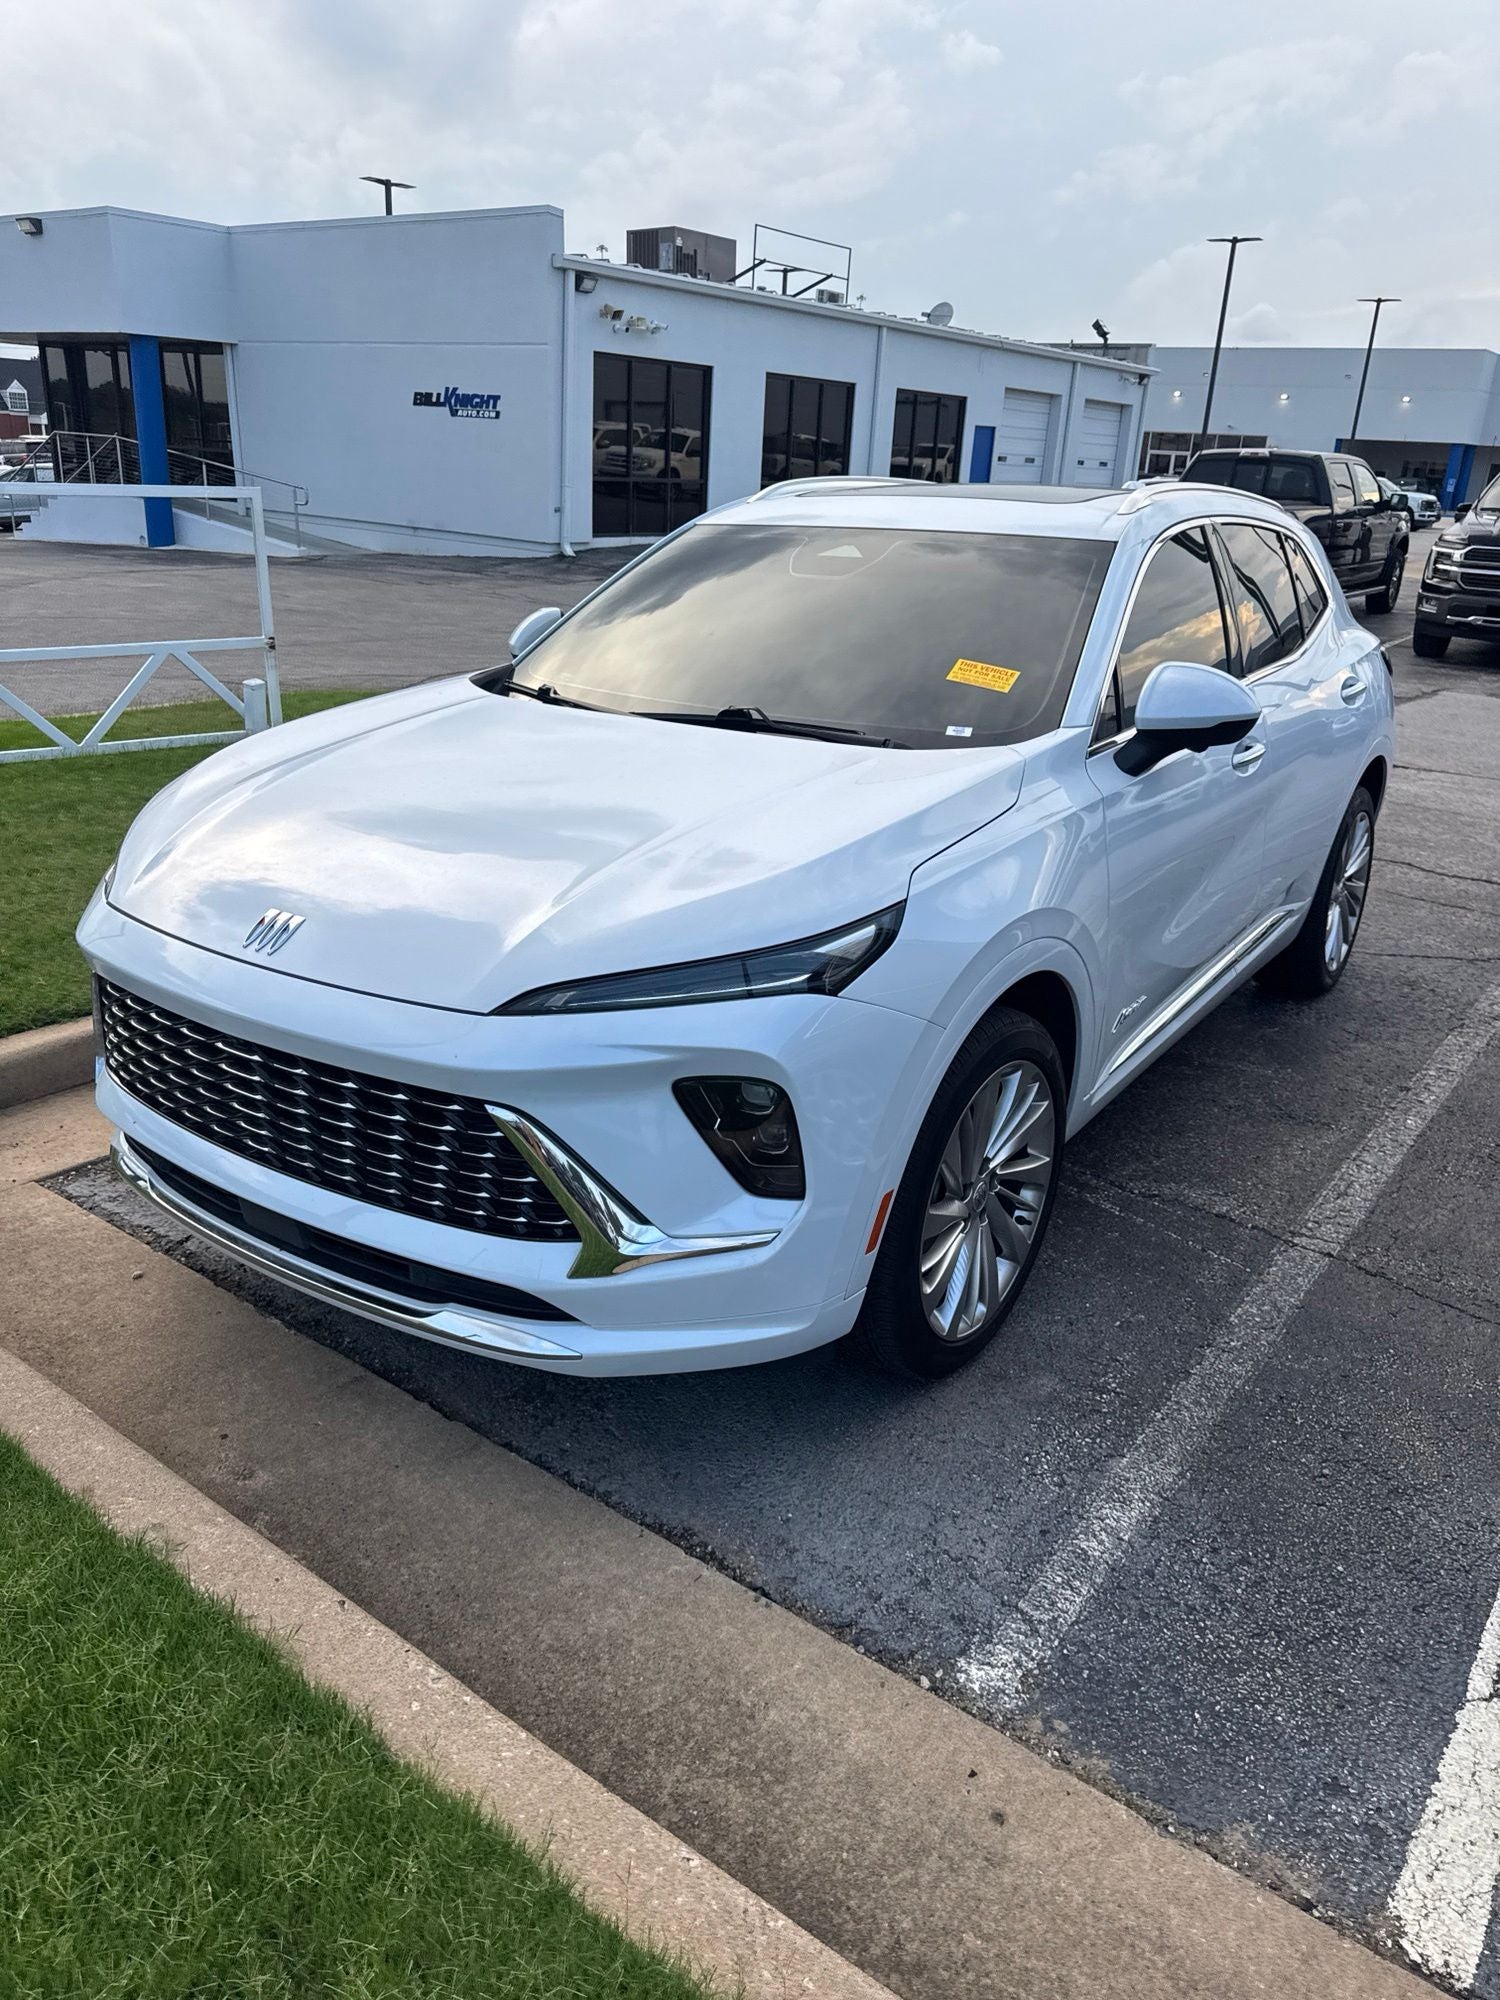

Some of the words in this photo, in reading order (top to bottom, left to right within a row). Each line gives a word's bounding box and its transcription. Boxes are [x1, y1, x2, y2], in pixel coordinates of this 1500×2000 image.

[457, 409, 496, 418] AUTO.COM
[959, 661, 978, 669] THIS
[980, 665, 1016, 678] VEHICLE
[974, 670, 990, 678] FOR
[991, 674, 1010, 682] SALE
